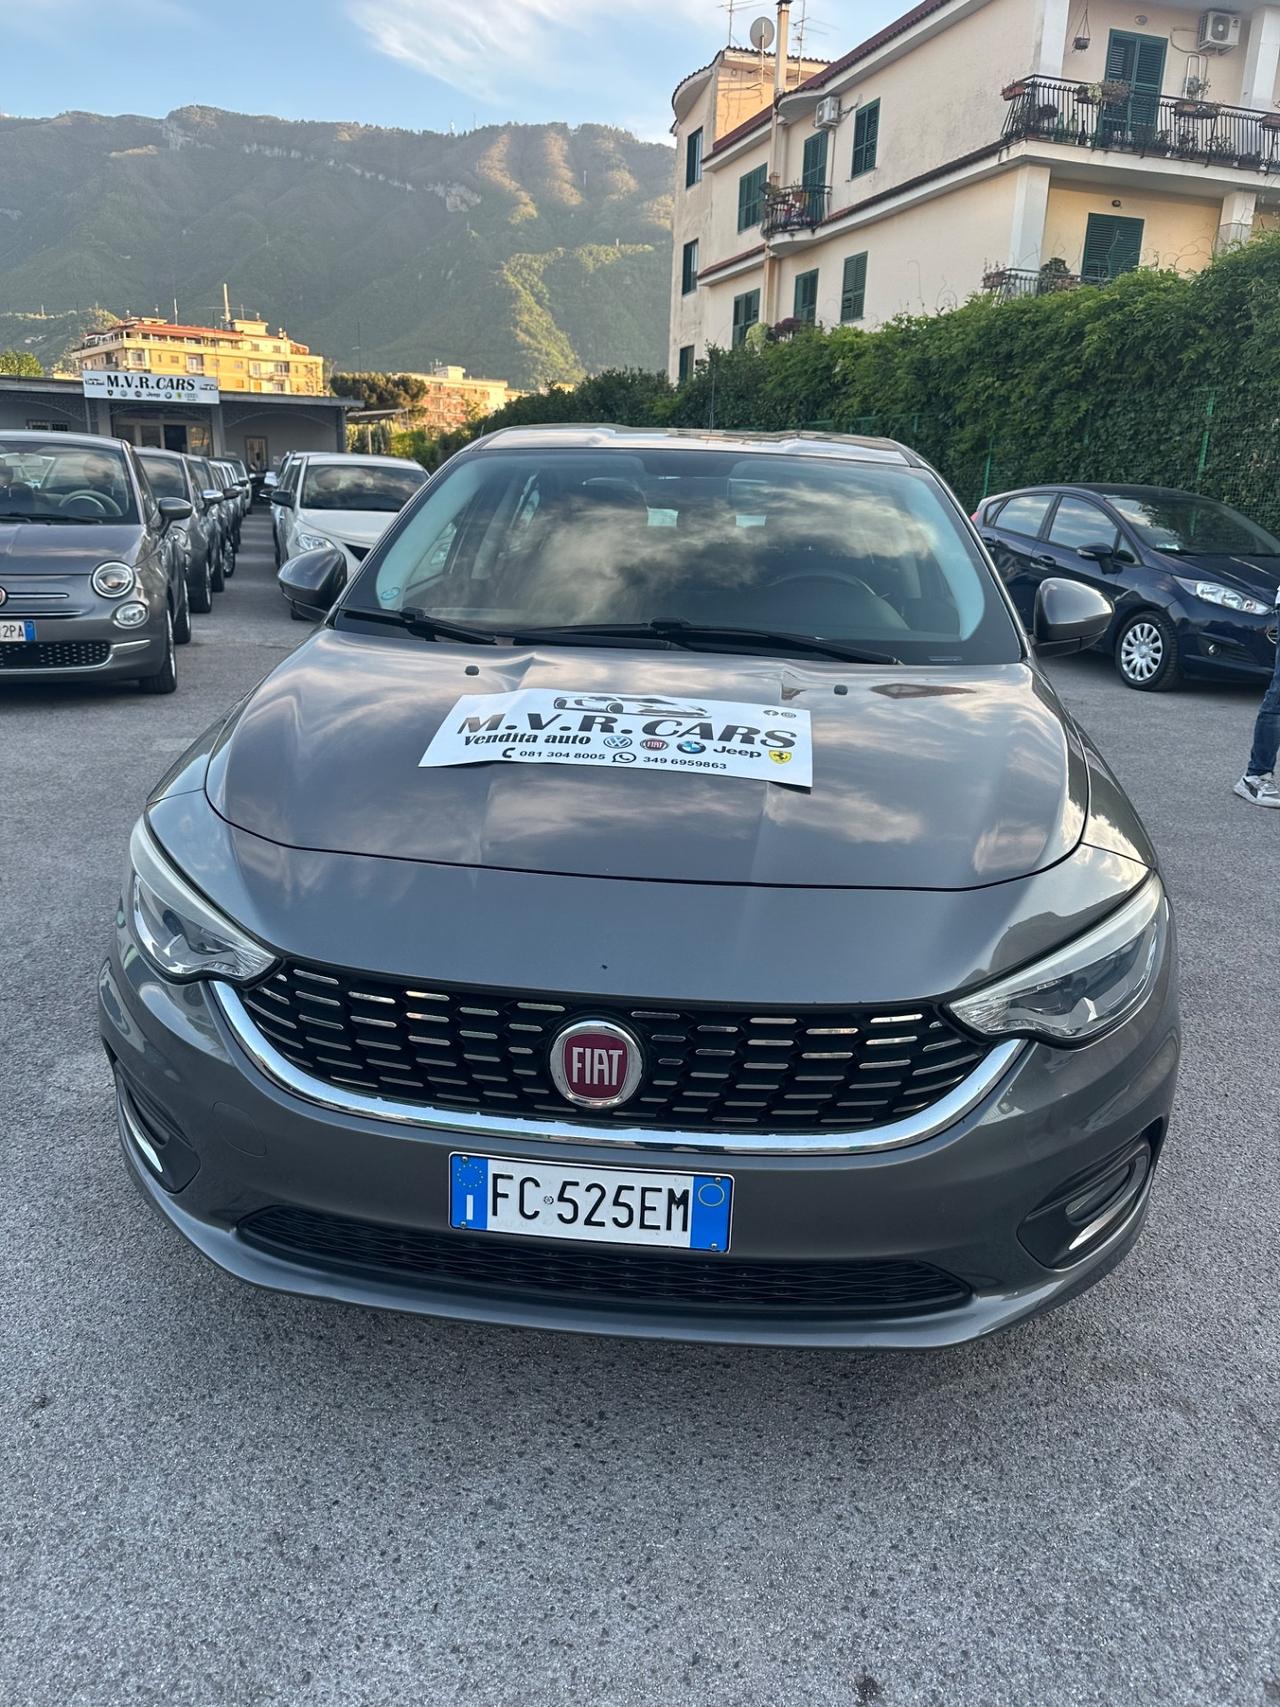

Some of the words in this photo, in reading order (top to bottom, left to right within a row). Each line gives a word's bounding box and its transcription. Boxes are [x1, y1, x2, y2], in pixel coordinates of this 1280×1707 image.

[544, 734, 591, 745] auto
[519, 750, 542, 758] 081
[547, 750, 570, 759] 304
[574, 752, 606, 760] 8005
[713, 745, 762, 758] Jeep
[671, 759, 727, 770] 6959863
[572, 1046, 623, 1086] FIAT
